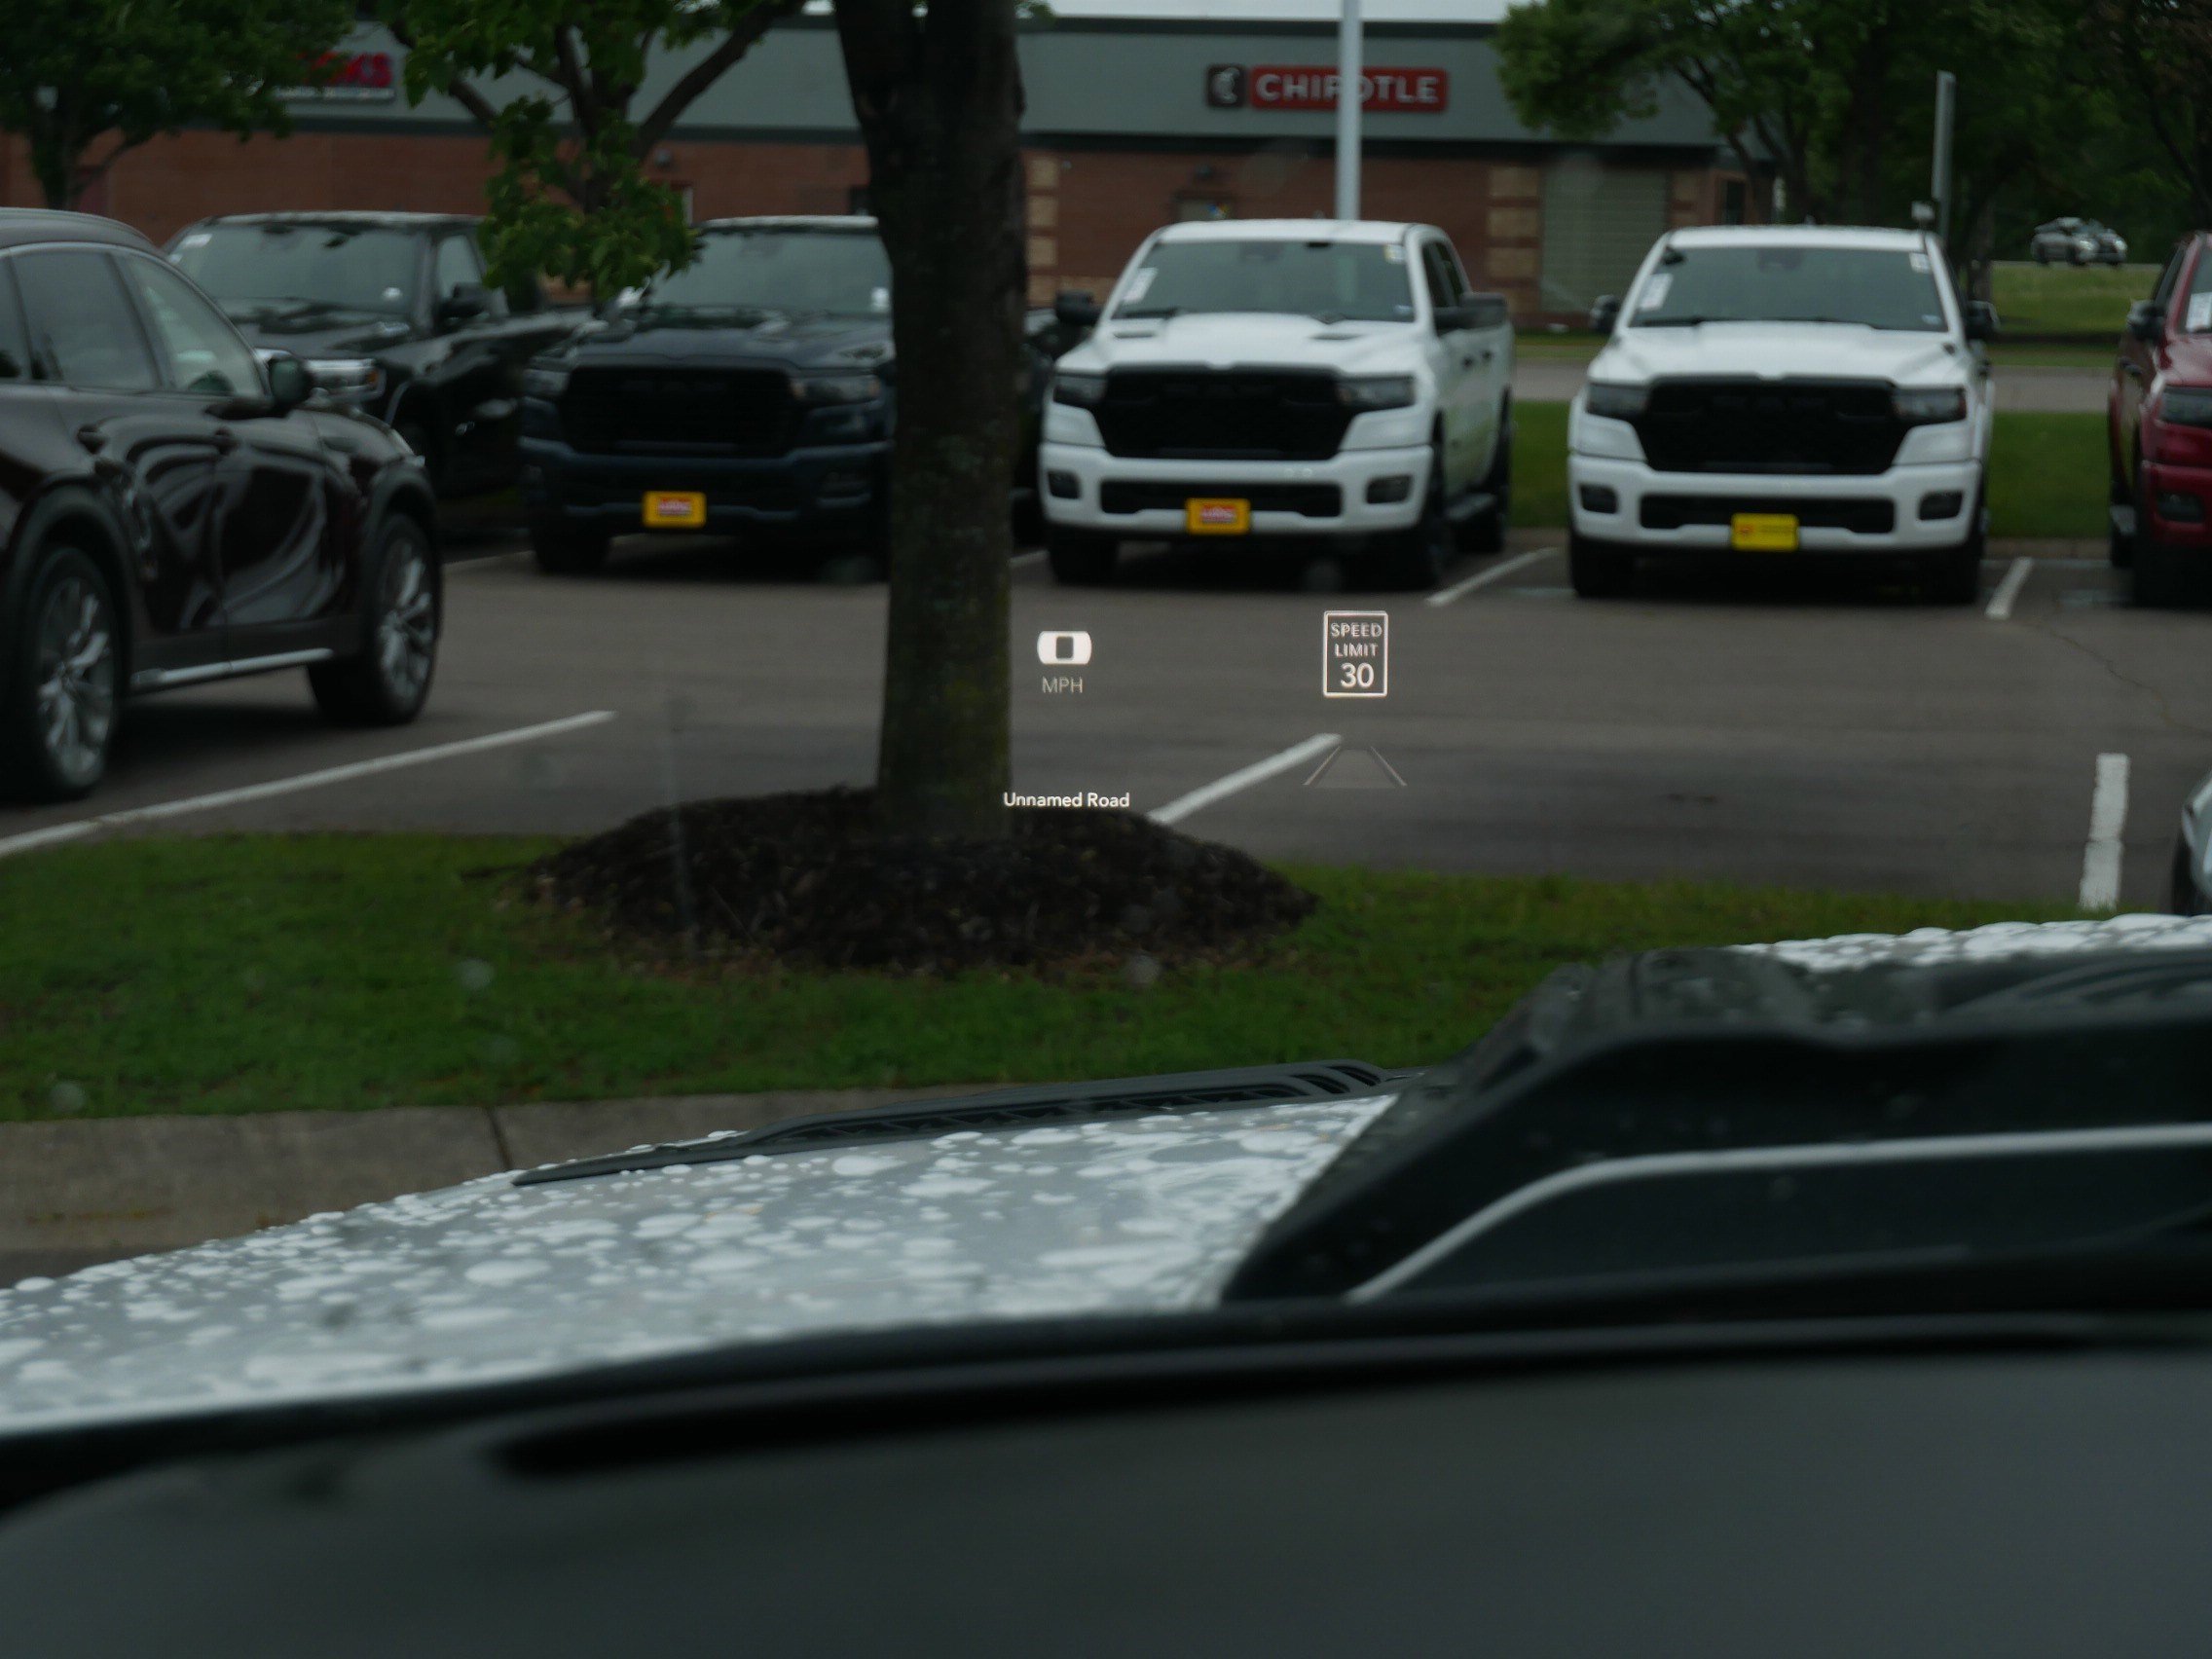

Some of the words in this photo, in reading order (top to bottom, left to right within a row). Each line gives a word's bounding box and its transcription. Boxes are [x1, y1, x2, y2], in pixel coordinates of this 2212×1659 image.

[1330, 622, 1382, 637] SPEED
[1334, 643, 1379, 657] LIMIT
[1340, 662, 1375, 688] 30
[1042, 676, 1084, 693] MPH
[1003, 791, 1083, 808] Unnamed
[1087, 792, 1130, 808] Road
